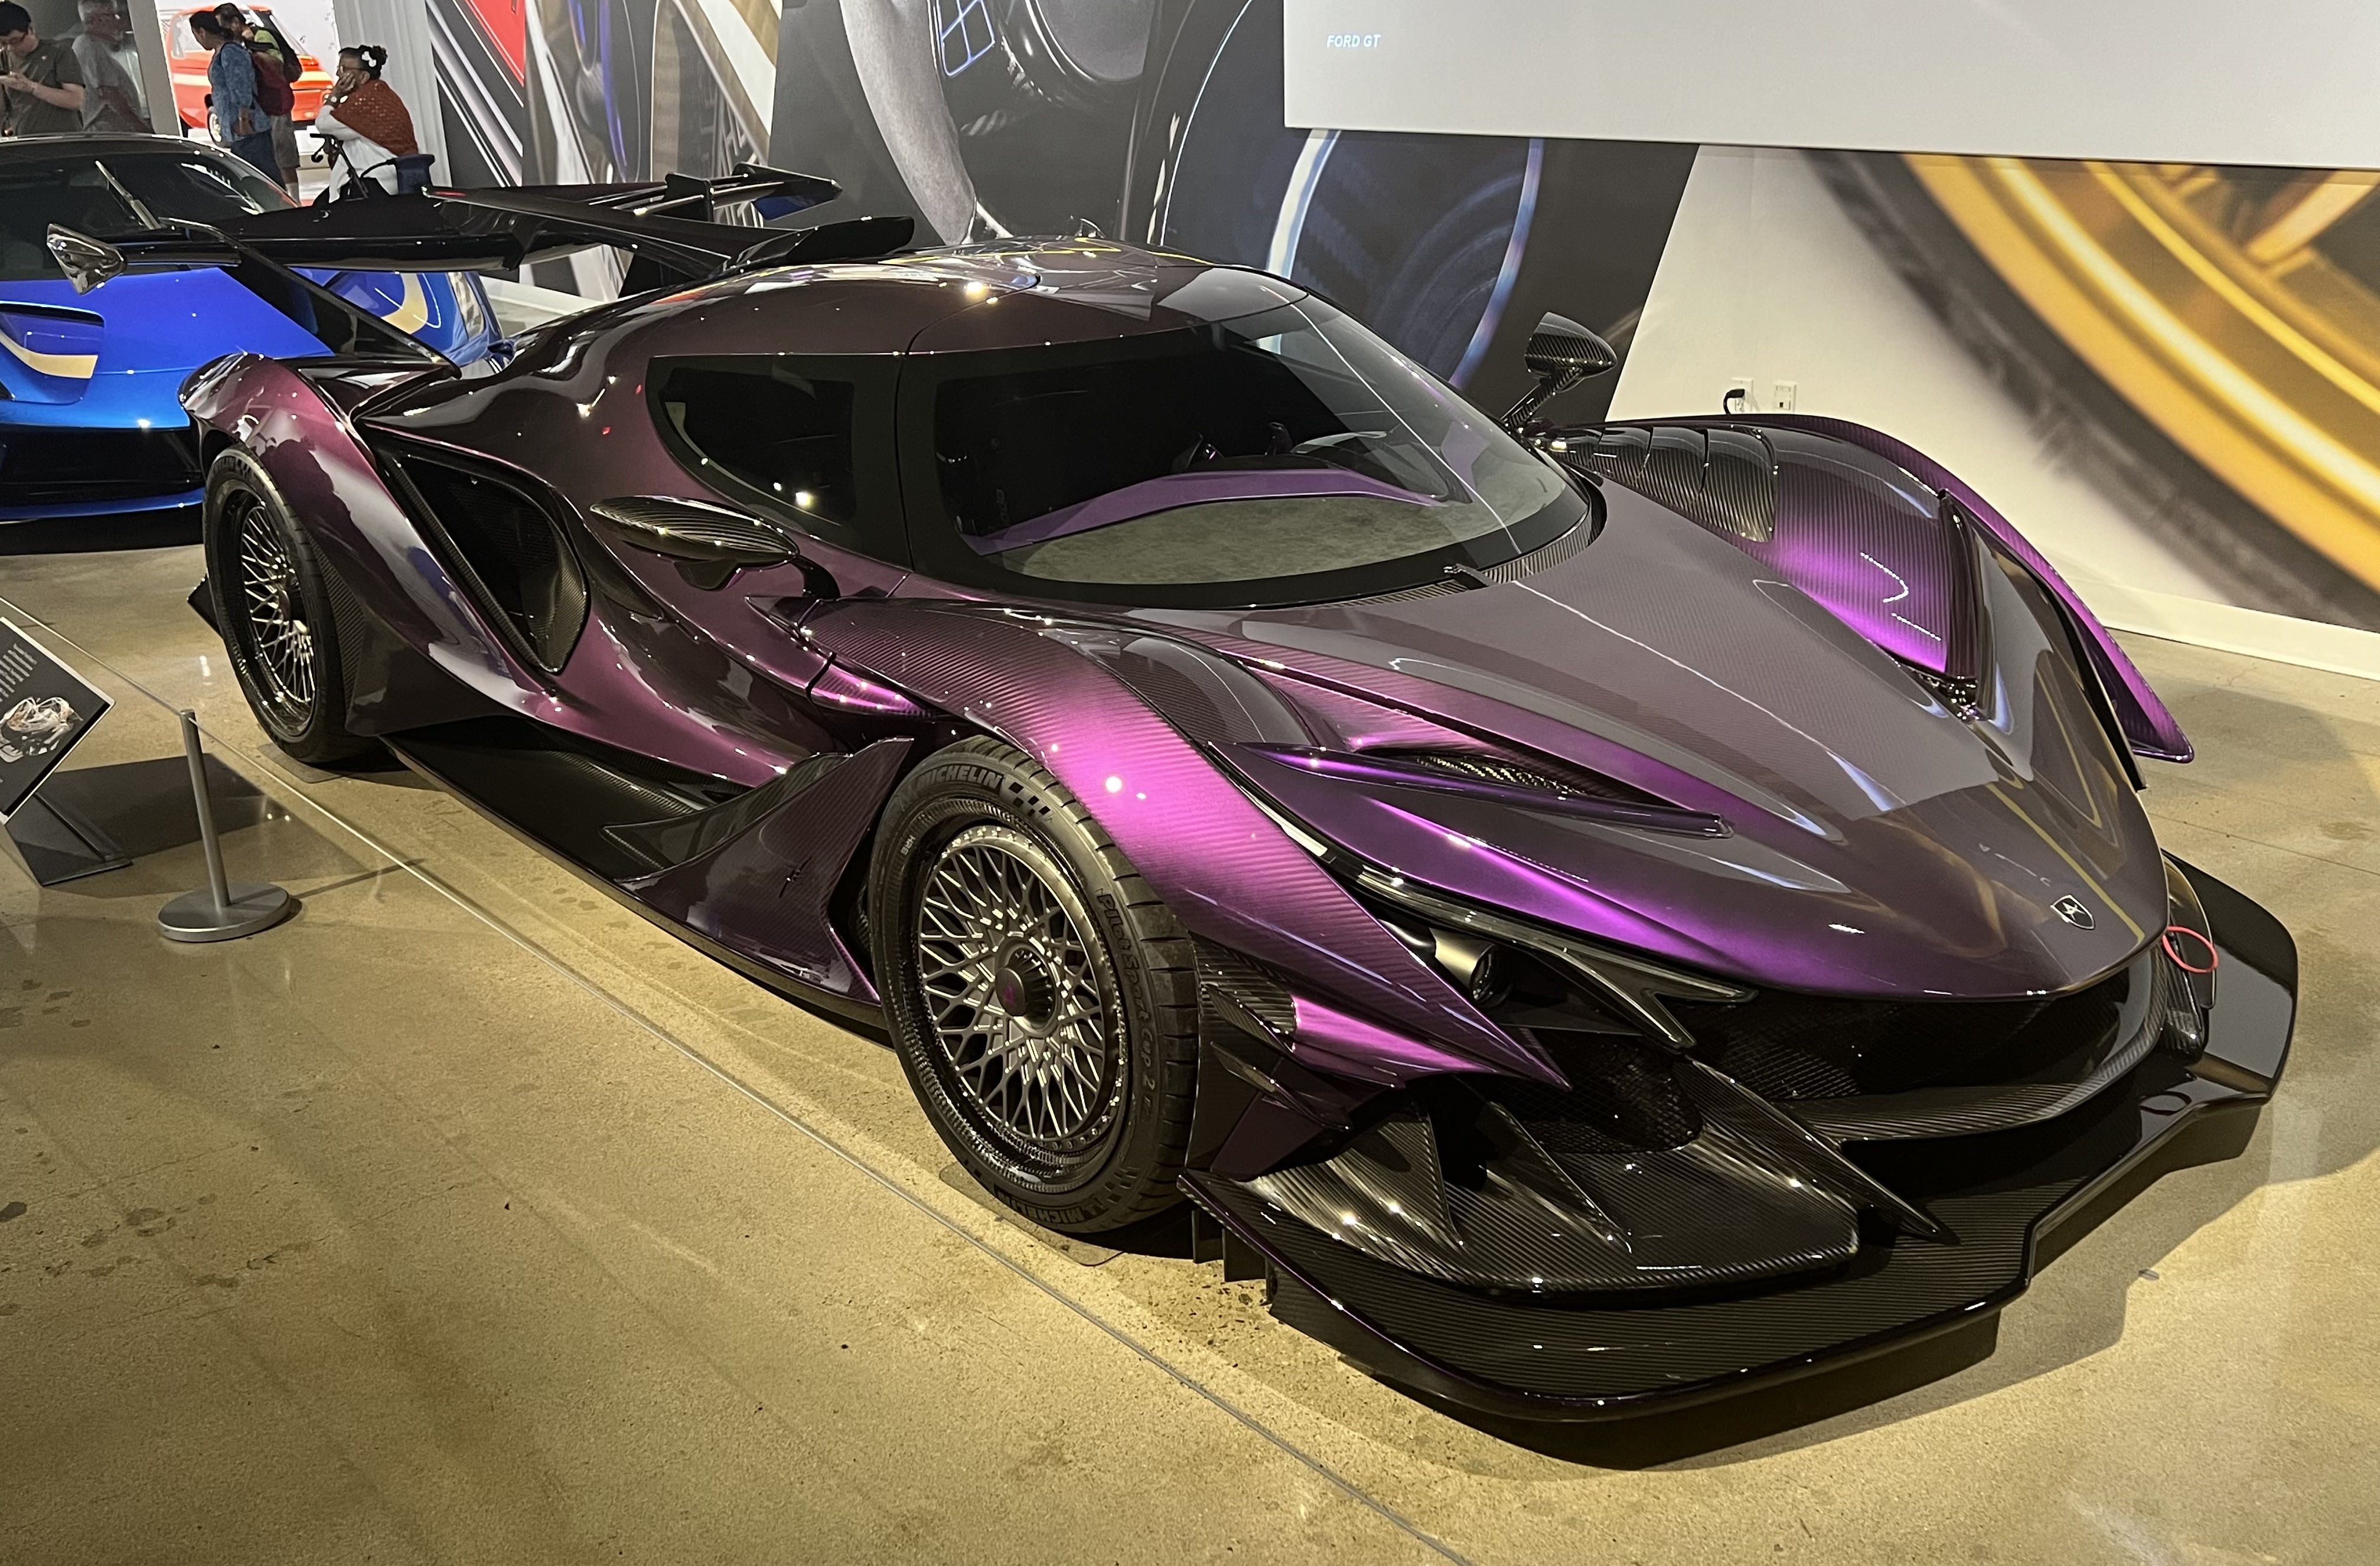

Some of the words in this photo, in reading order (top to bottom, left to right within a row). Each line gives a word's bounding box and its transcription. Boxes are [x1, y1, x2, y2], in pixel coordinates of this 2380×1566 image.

[1326, 35, 1361, 48] FORD
[1363, 34, 1381, 48] GT
[917, 765, 1004, 790] MICHELIN
[1097, 893, 1132, 950] Pilot
[1124, 953, 1150, 1020] Sport
[1140, 1027, 1153, 1067] Cup
[1142, 1072, 1156, 1091] 2
